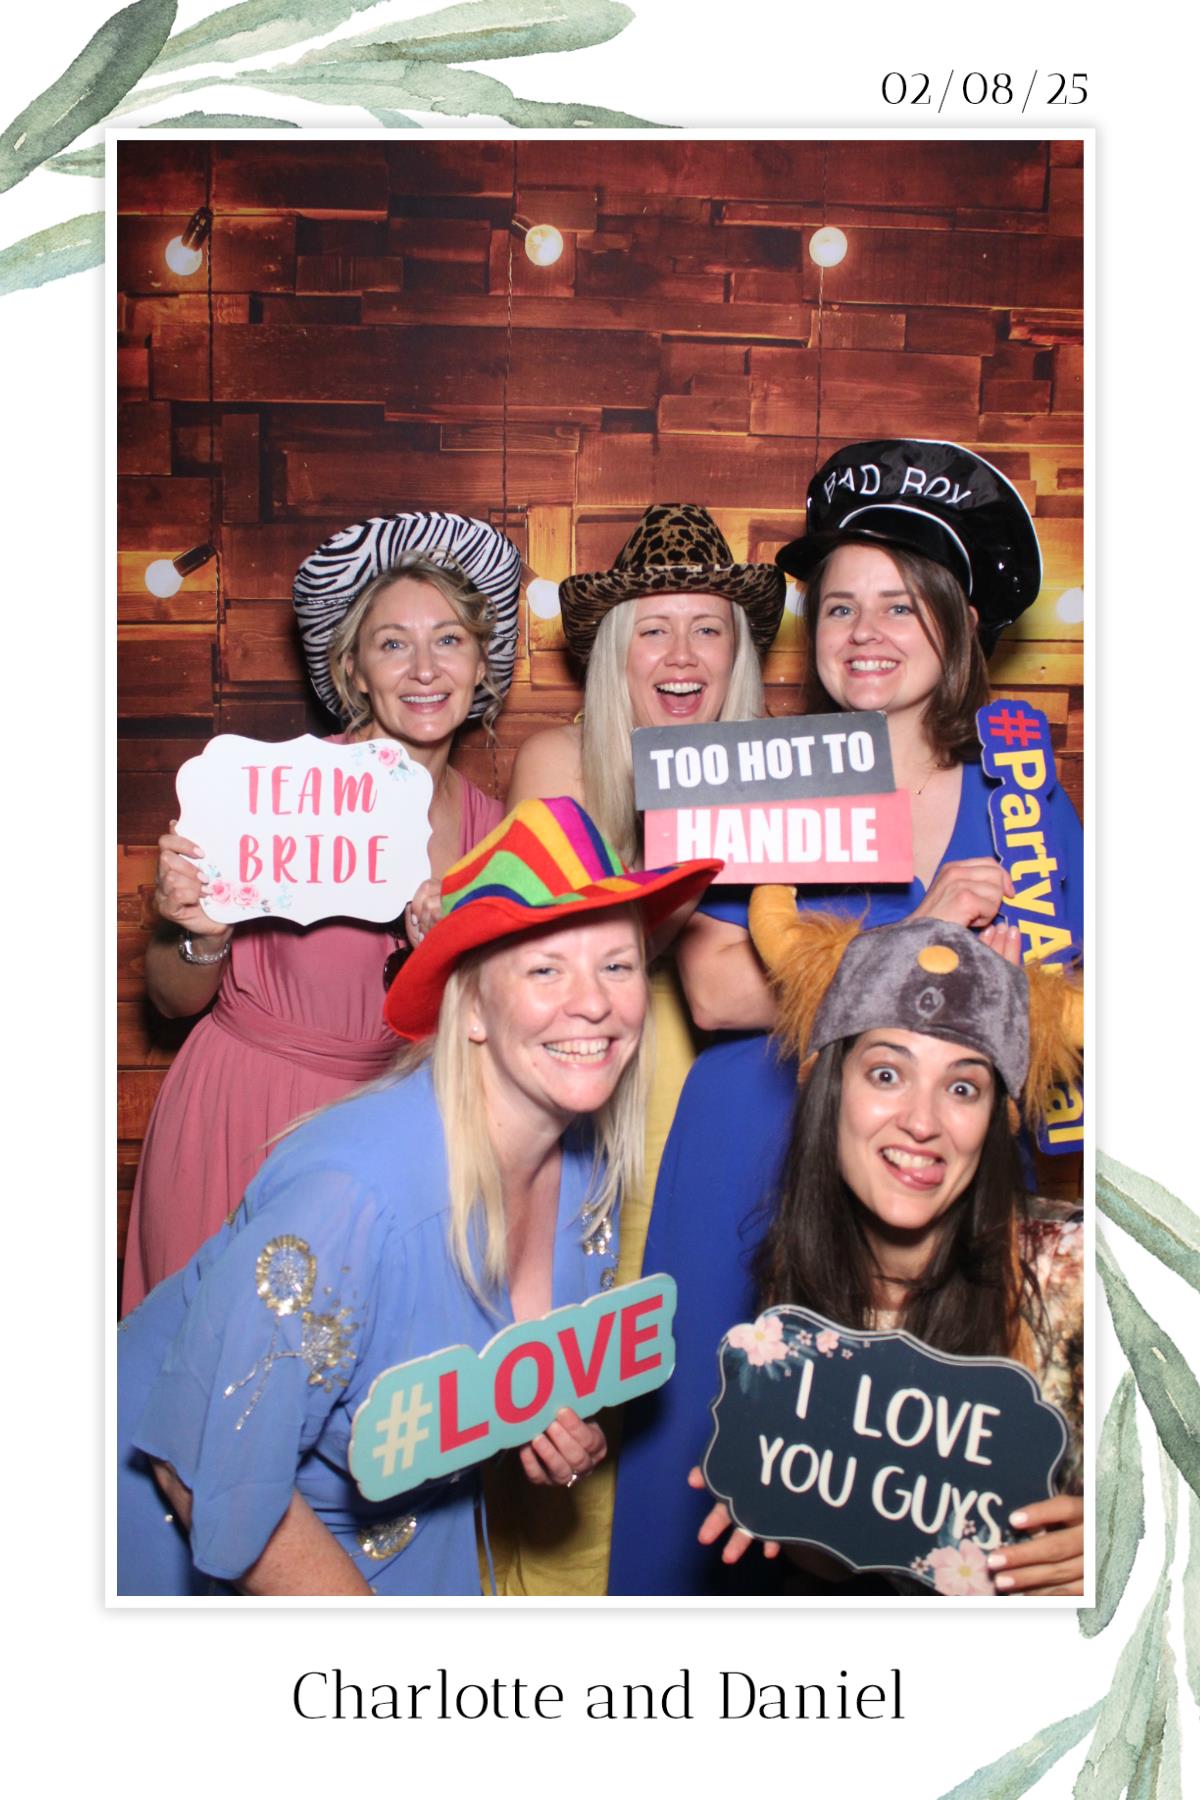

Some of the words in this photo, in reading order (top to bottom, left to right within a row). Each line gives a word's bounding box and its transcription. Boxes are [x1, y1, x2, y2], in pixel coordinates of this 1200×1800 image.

[823, 464, 880, 503] BAD
[651, 744, 729, 790] TOO
[737, 736, 815, 782] HOT
[823, 731, 875, 774] TO
[241, 765, 378, 817] TEAM
[239, 834, 389, 884] BRIDE
[676, 808, 879, 863] HANDLE
[988, 708, 1084, 1144] #PartyAal
[372, 1294, 664, 1478] #LOVE
[796, 1359, 814, 1419] I
[853, 1374, 1001, 1466] LOVE
[759, 1434, 857, 1507] YOU
[872, 1465, 1003, 1551] GUYS
